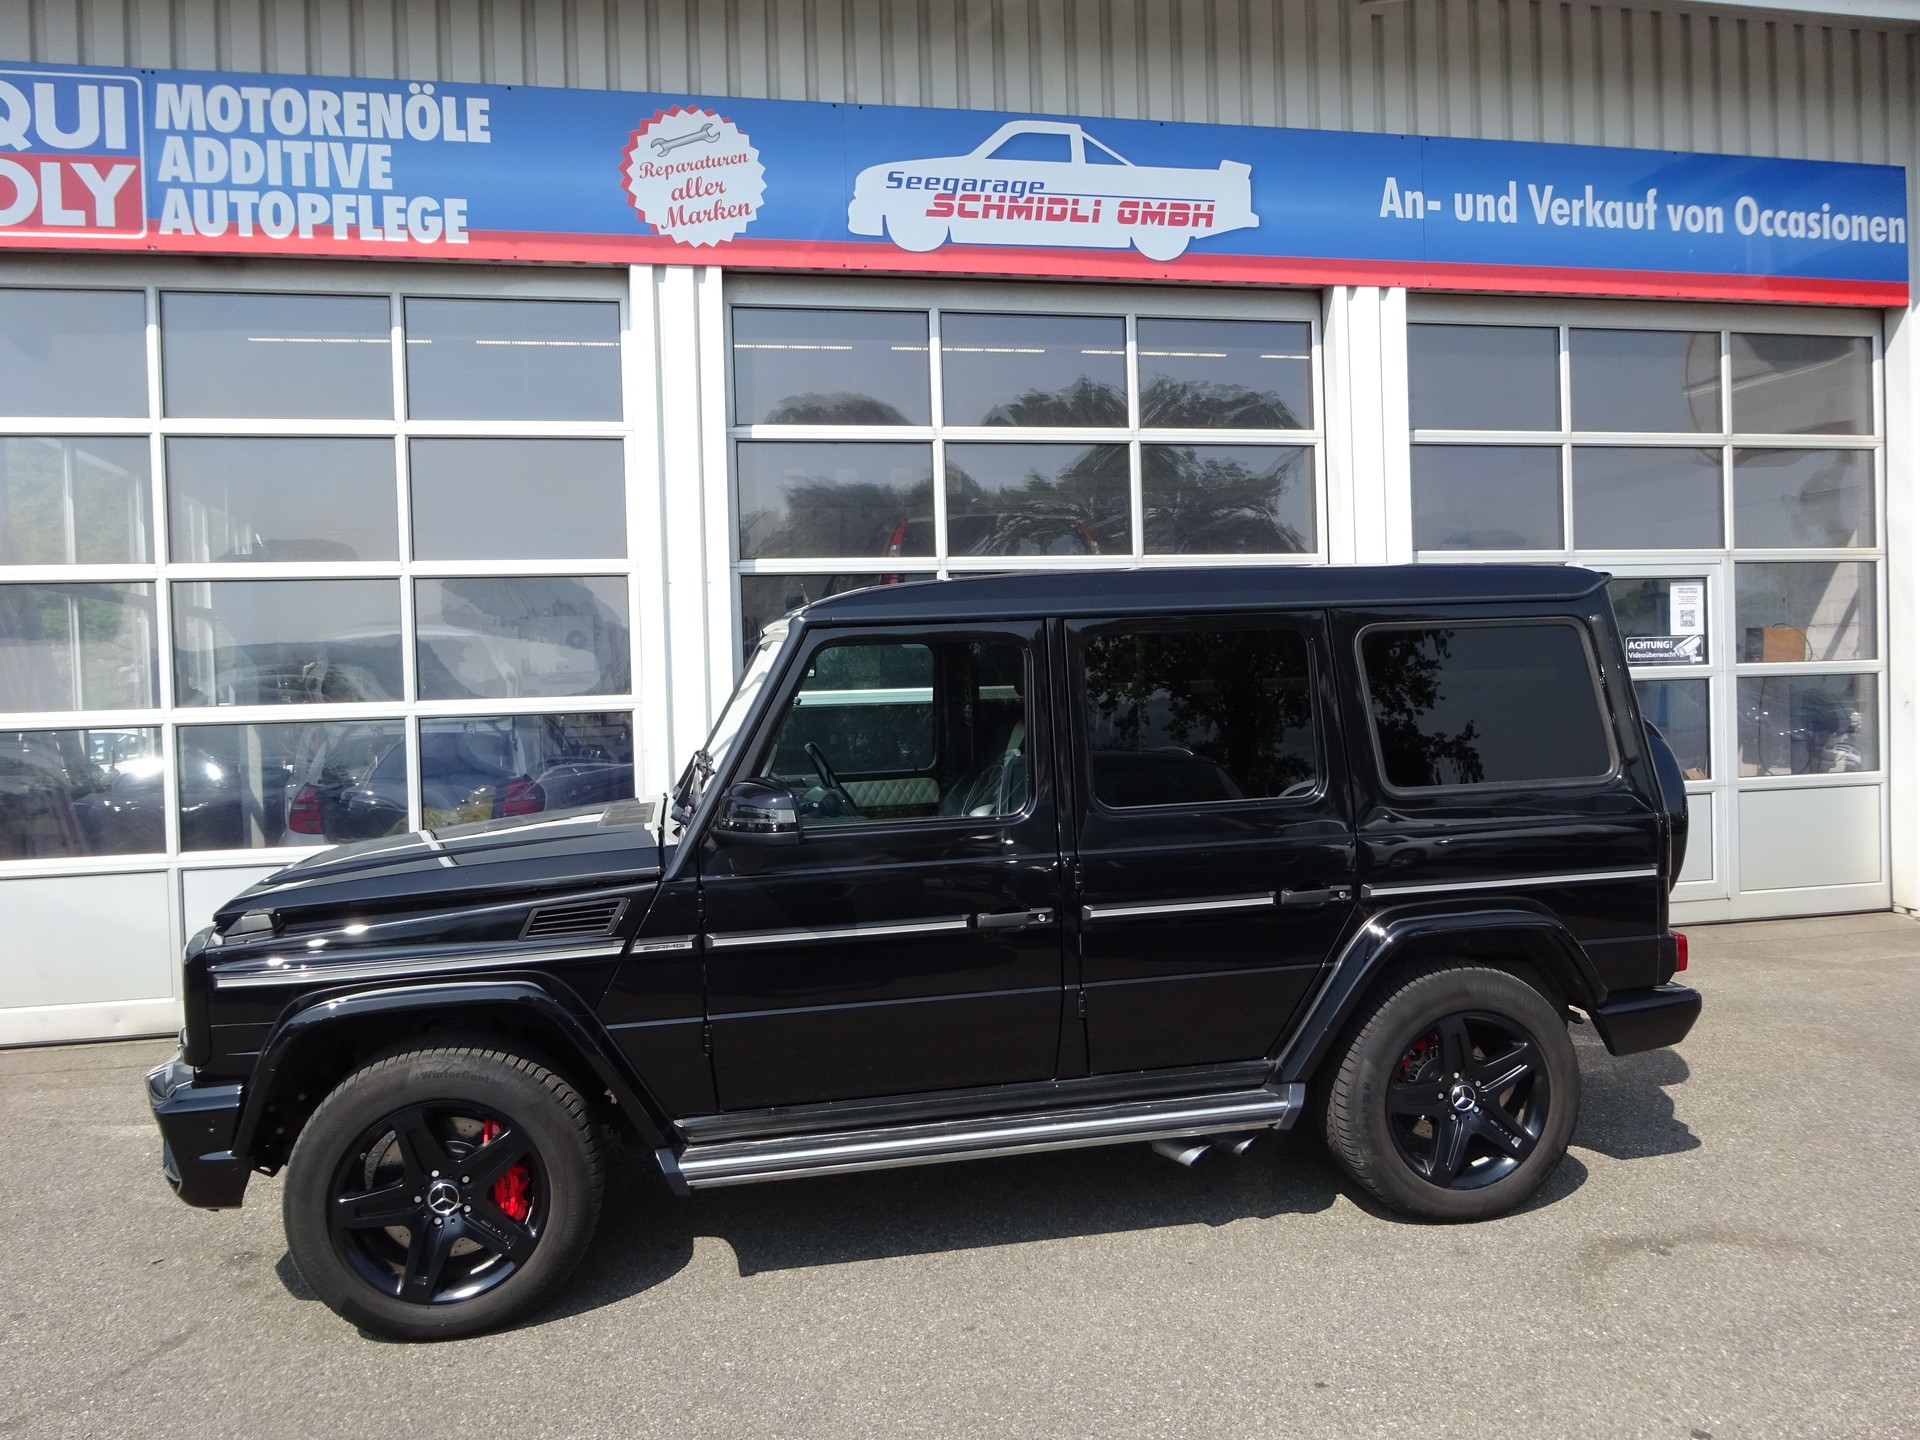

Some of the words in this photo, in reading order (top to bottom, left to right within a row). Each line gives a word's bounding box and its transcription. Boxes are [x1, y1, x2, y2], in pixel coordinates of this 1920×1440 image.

[155, 82, 491, 144] MOTORENÖLE
[157, 135, 393, 190] ADDITIVE
[639, 152, 750, 180] Reparaturen
[670, 175, 727, 202] aller
[886, 171, 1045, 199] Seegarage
[159, 187, 470, 245] AUTOPFLEGE
[660, 198, 752, 230] Marken
[1379, 177, 1441, 219] An-
[1454, 181, 1518, 223] und
[1528, 183, 1658, 231] Verkauf
[1667, 203, 1724, 234] von
[1735, 196, 1907, 244] Occasionen
[1628, 641, 1673, 649] ACHTUNG!
[1628, 651, 1677, 659] Videoüberwacht
